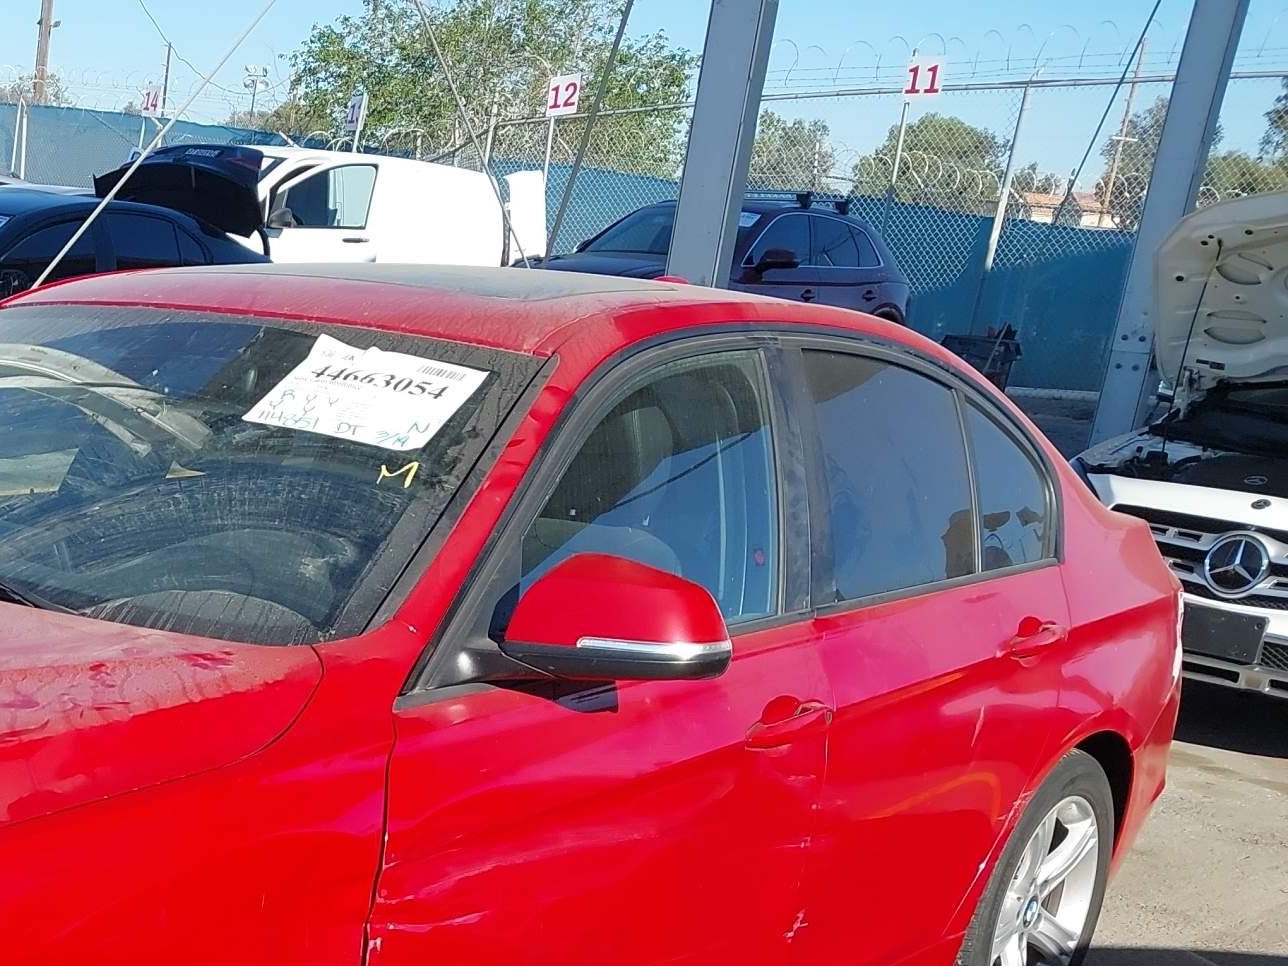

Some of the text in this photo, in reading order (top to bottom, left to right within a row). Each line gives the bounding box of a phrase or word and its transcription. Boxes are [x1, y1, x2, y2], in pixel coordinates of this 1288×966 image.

[904, 64, 939, 94] 11
[143, 91, 159, 112] 14
[549, 82, 578, 109] 12
[311, 364, 449, 400] 44663054
[376, 461, 420, 489] M
